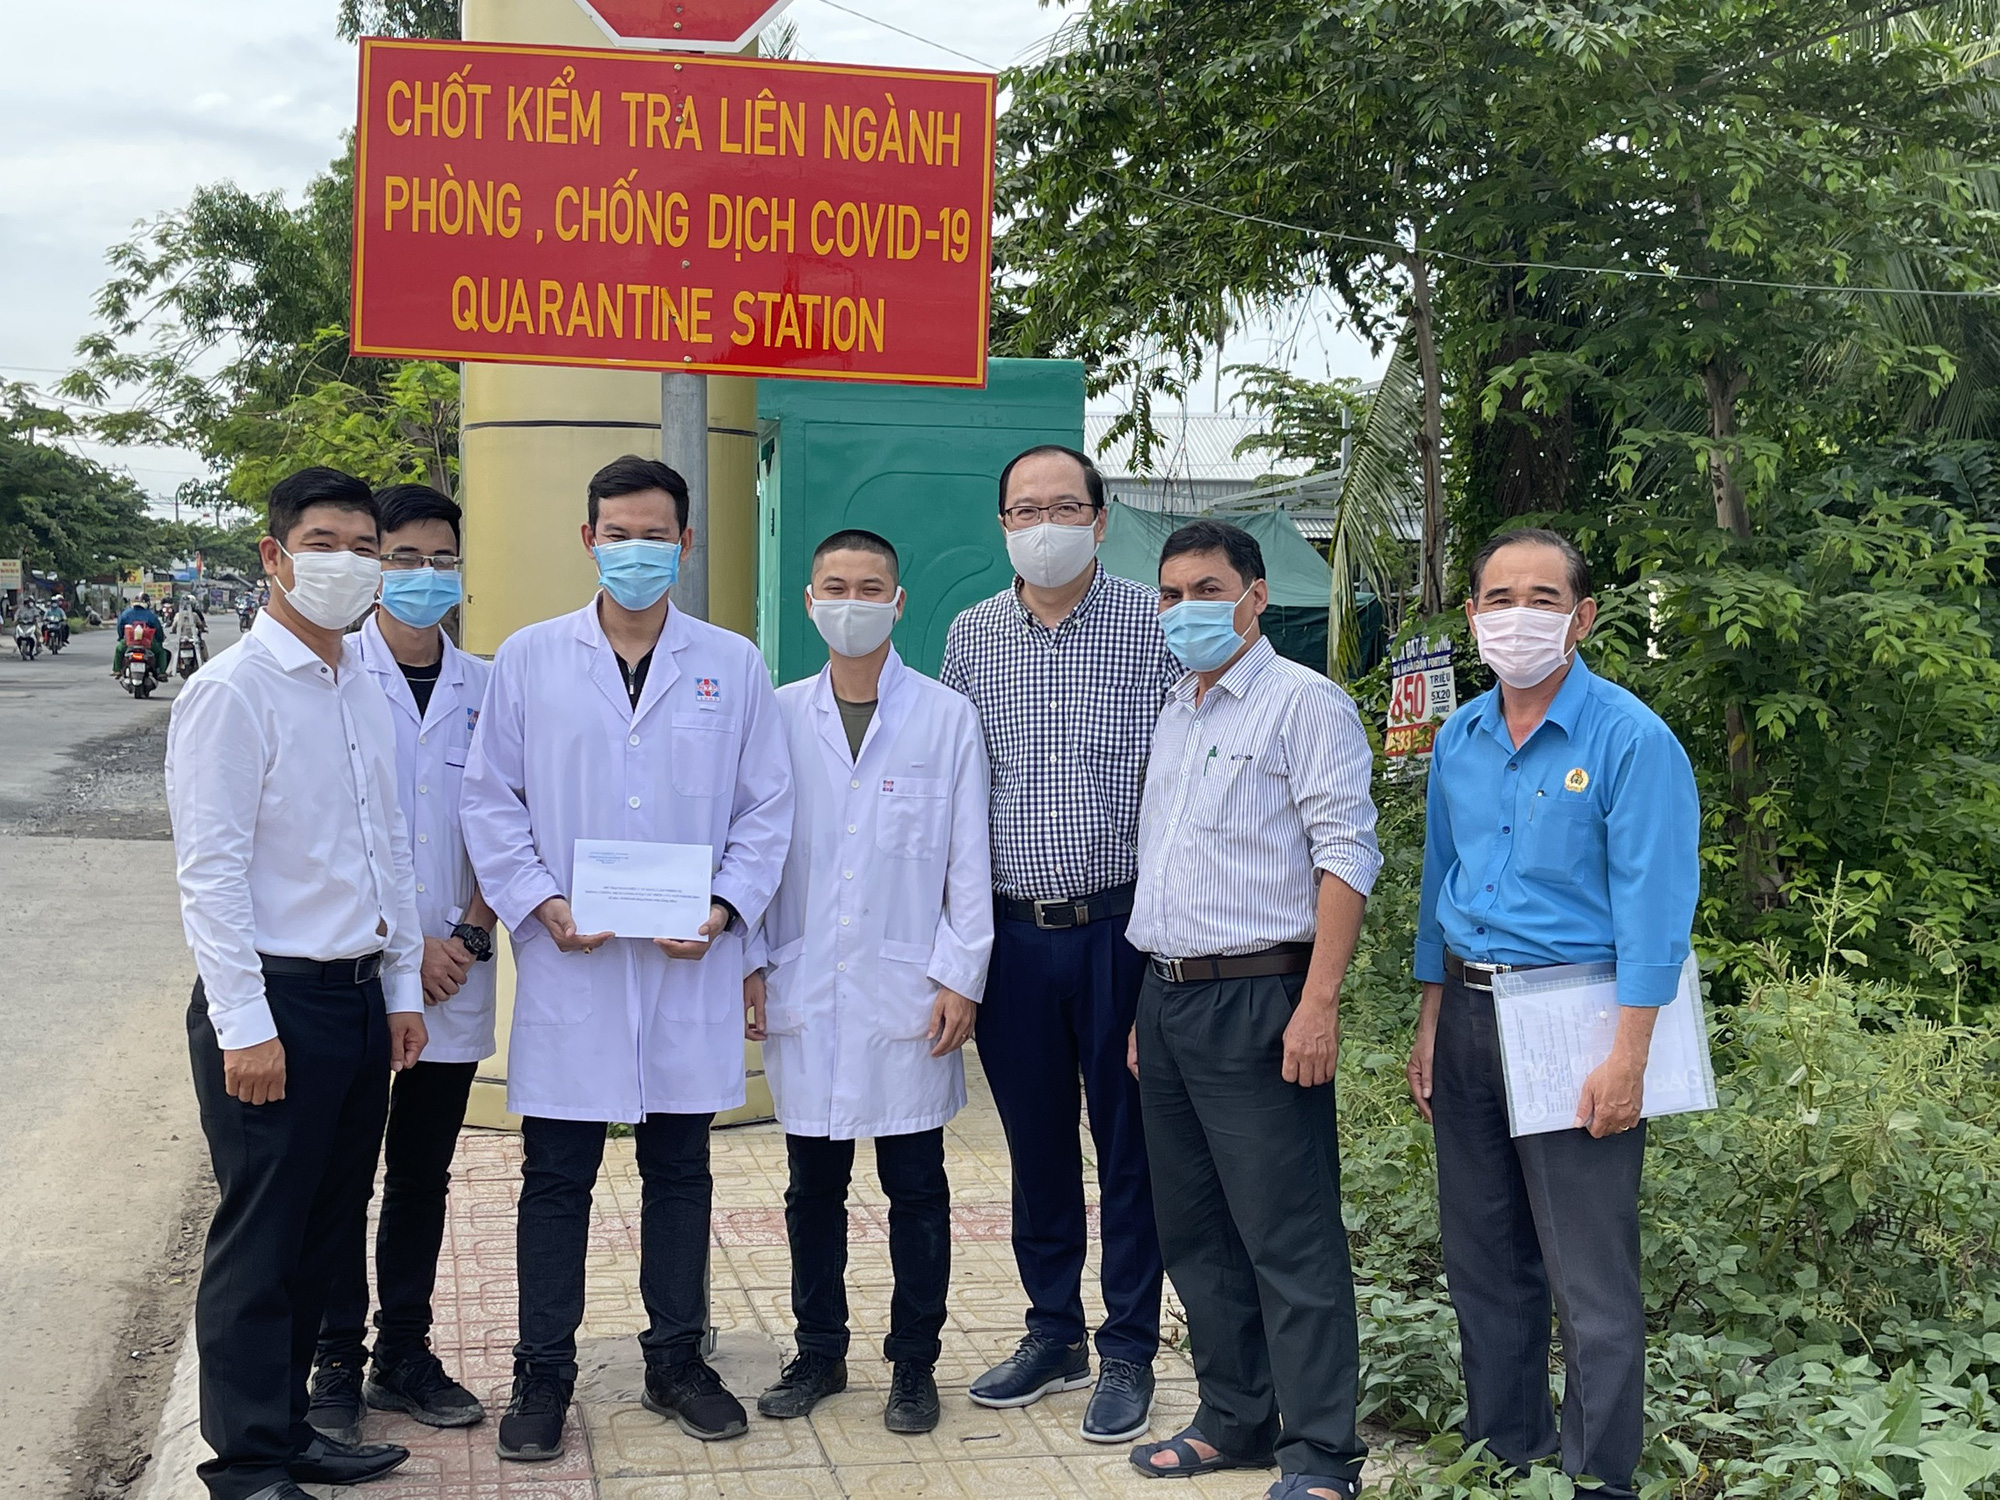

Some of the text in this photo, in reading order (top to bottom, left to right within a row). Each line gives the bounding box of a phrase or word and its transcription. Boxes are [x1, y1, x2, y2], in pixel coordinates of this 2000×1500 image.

[386, 63, 960, 167] CHỐT KIỂM TRA LIÊN NGÀNH
[384, 163, 522, 239] PHÒNG
[554, 167, 690, 249] CHỐNG
[708, 193, 796, 262] DỊCH
[810, 199, 971, 263] COVID-19
[451, 275, 886, 353] QUARANTINE STATION
[1392, 673, 1426, 719] 650
